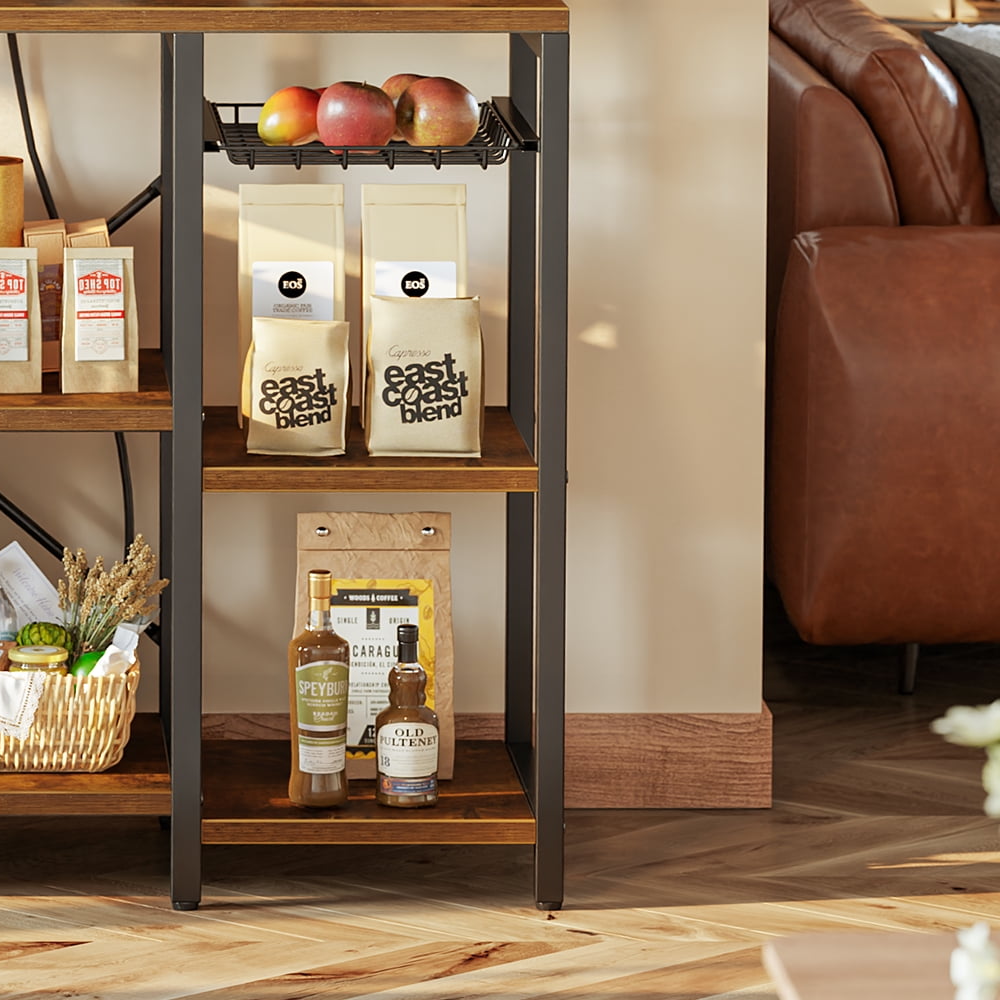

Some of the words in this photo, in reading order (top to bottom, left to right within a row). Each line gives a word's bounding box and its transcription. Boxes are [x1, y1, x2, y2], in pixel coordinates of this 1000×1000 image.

[388, 344, 432, 360] Capresso
[264, 360, 304, 376] Capresso
[384, 353, 457, 387] east
[260, 368, 327, 398] east
[382, 370, 469, 407] coast
[259, 383, 338, 415] coast
[400, 396, 462, 423] blend
[275, 405, 332, 430] blend
[299, 679, 347, 697] SPEYBUR
[380, 735, 438, 747] PULTENEY
[395, 729, 424, 737] OLD
